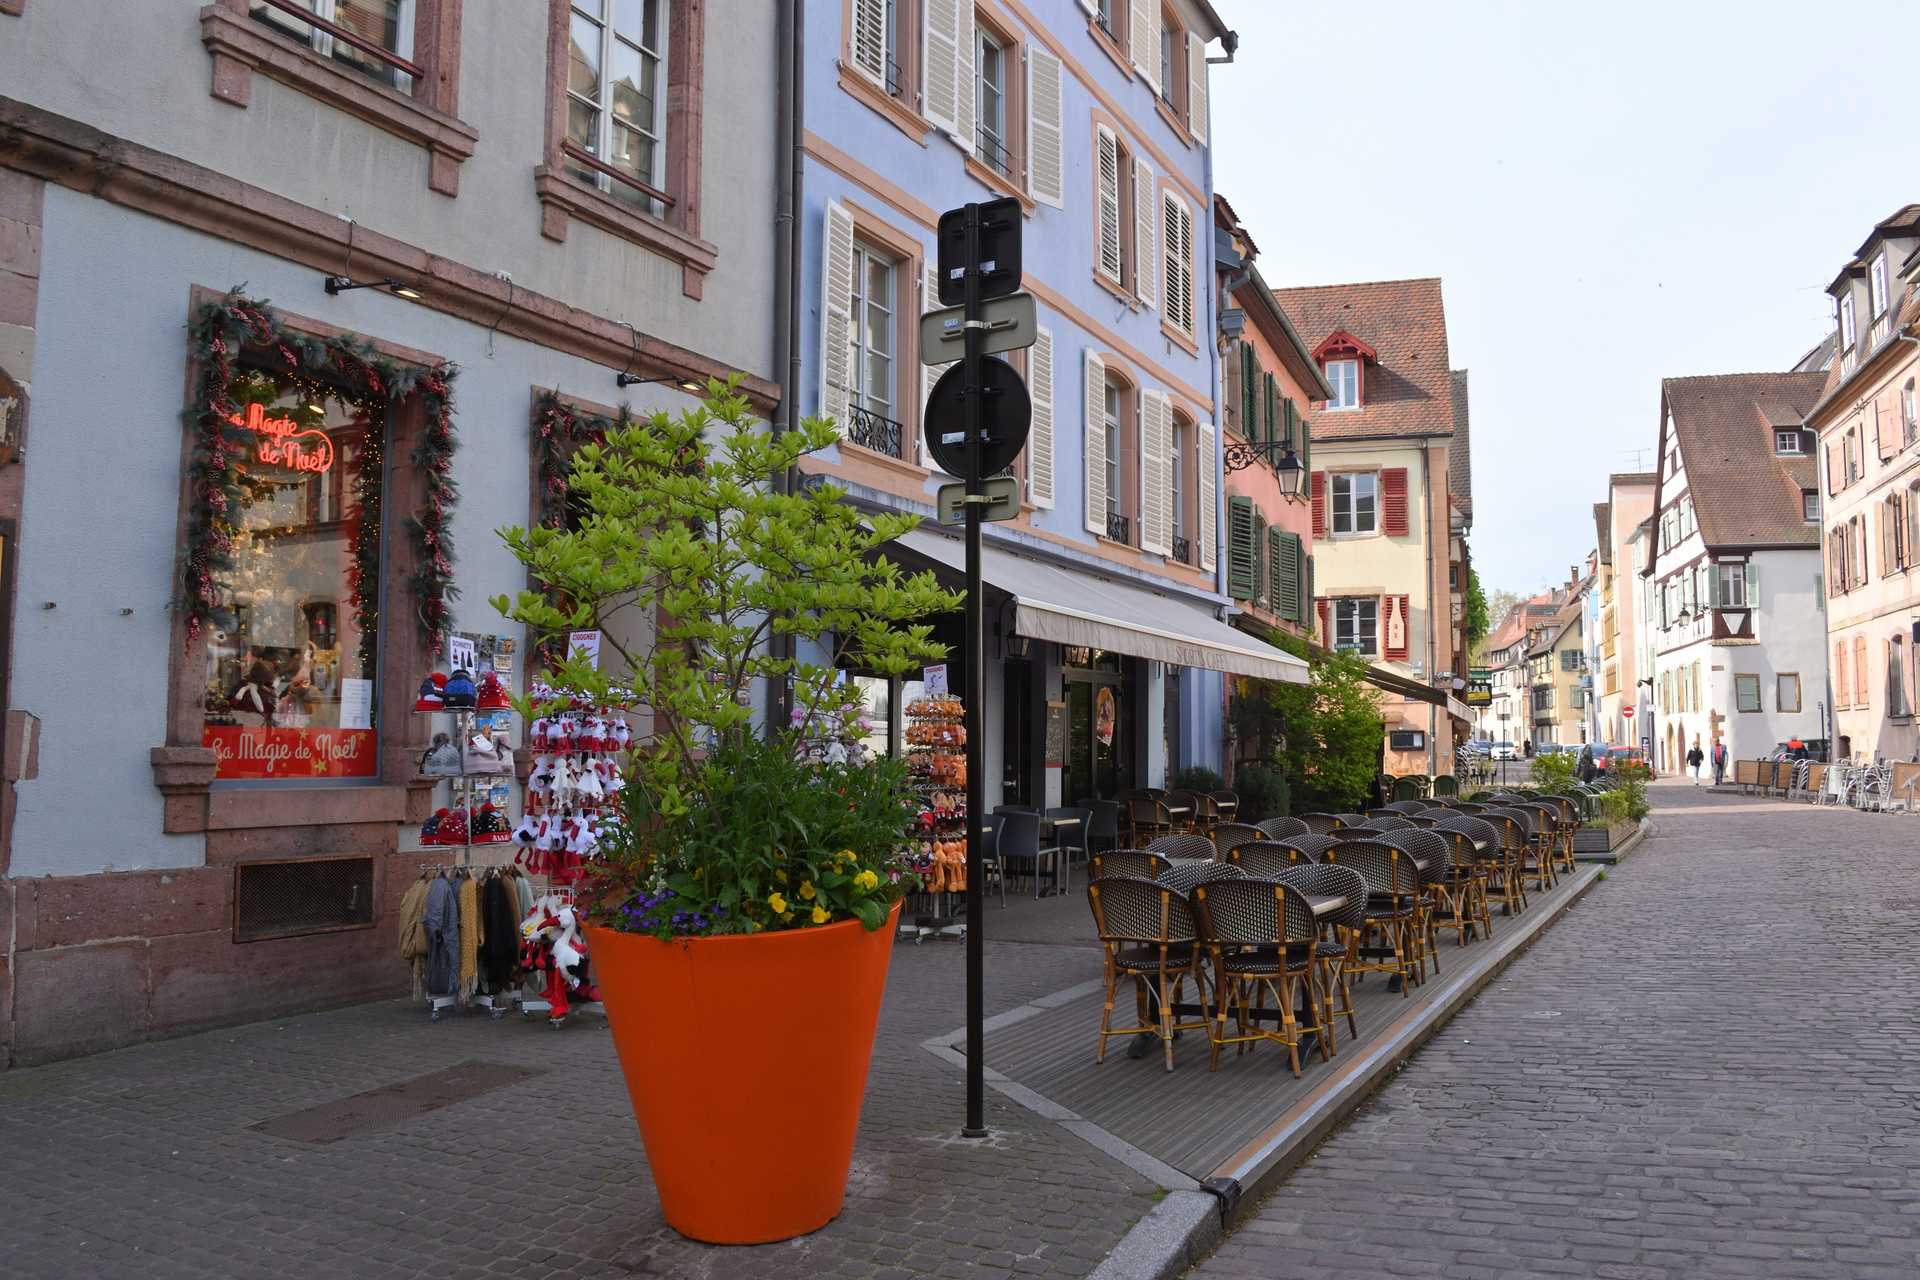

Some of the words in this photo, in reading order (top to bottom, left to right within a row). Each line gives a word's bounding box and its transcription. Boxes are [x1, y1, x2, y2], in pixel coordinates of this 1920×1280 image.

[247, 403, 298, 447] Magie
[260, 442, 279, 464] de
[282, 441, 326, 472] Noël
[212, 737, 234, 760] La
[238, 732, 291, 773] Magie
[294, 739, 312, 759] de
[315, 734, 358, 761] Noël
